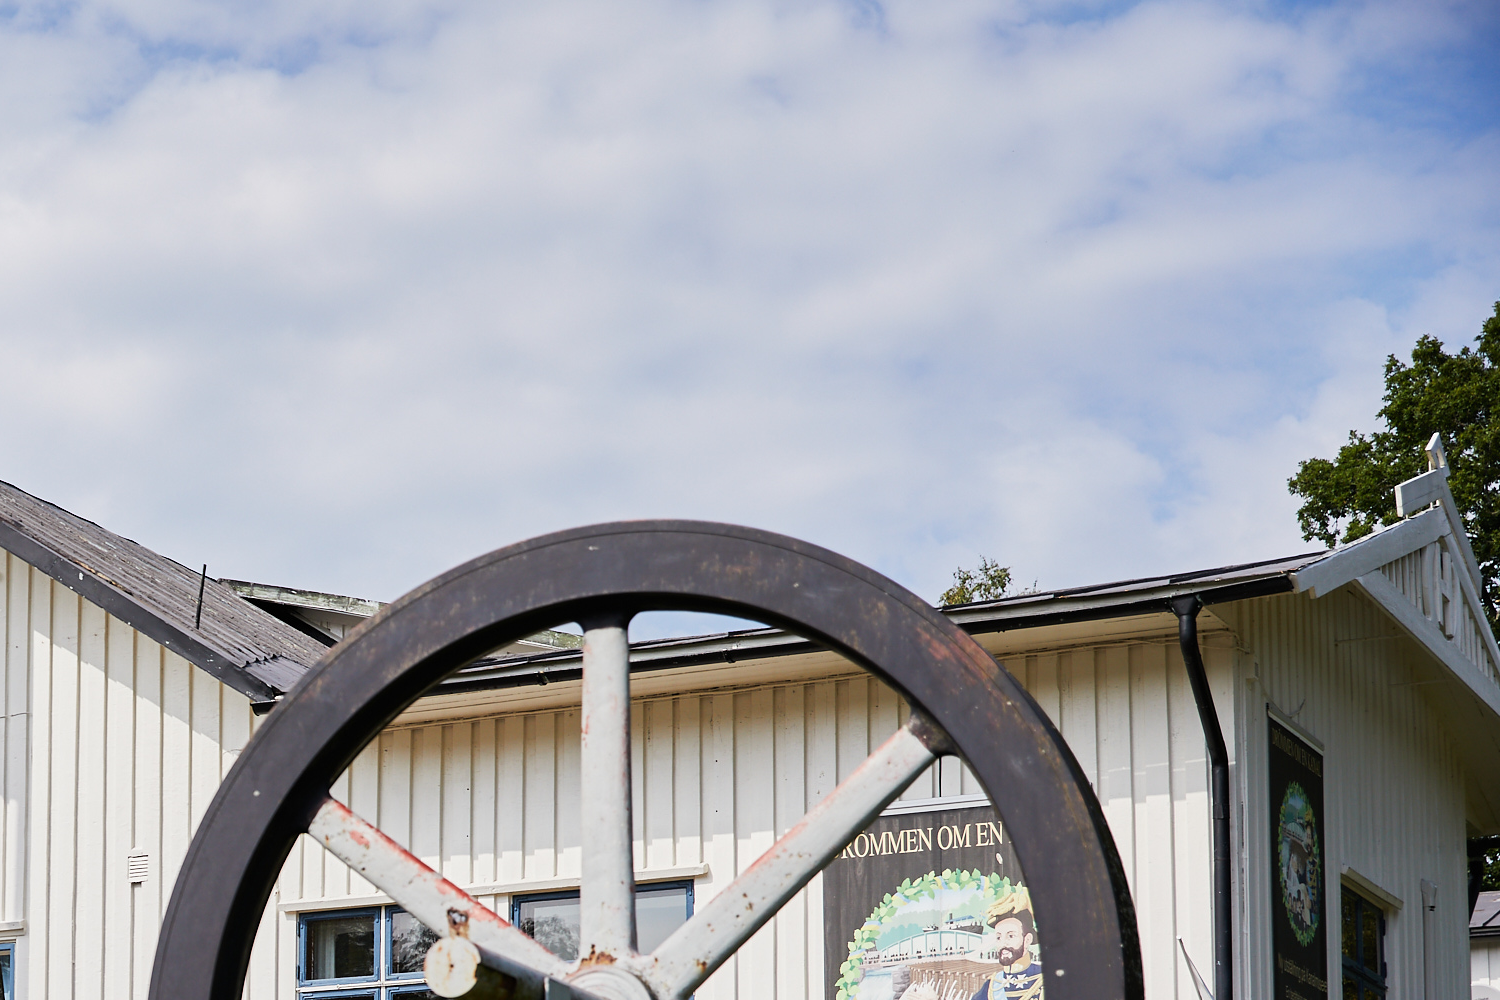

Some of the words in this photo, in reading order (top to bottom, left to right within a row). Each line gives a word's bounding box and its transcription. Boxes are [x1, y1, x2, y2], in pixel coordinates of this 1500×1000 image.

[834, 829, 933, 859] RÖMMEN
[937, 823, 971, 851] OM
[975, 820, 1003, 846] EN
